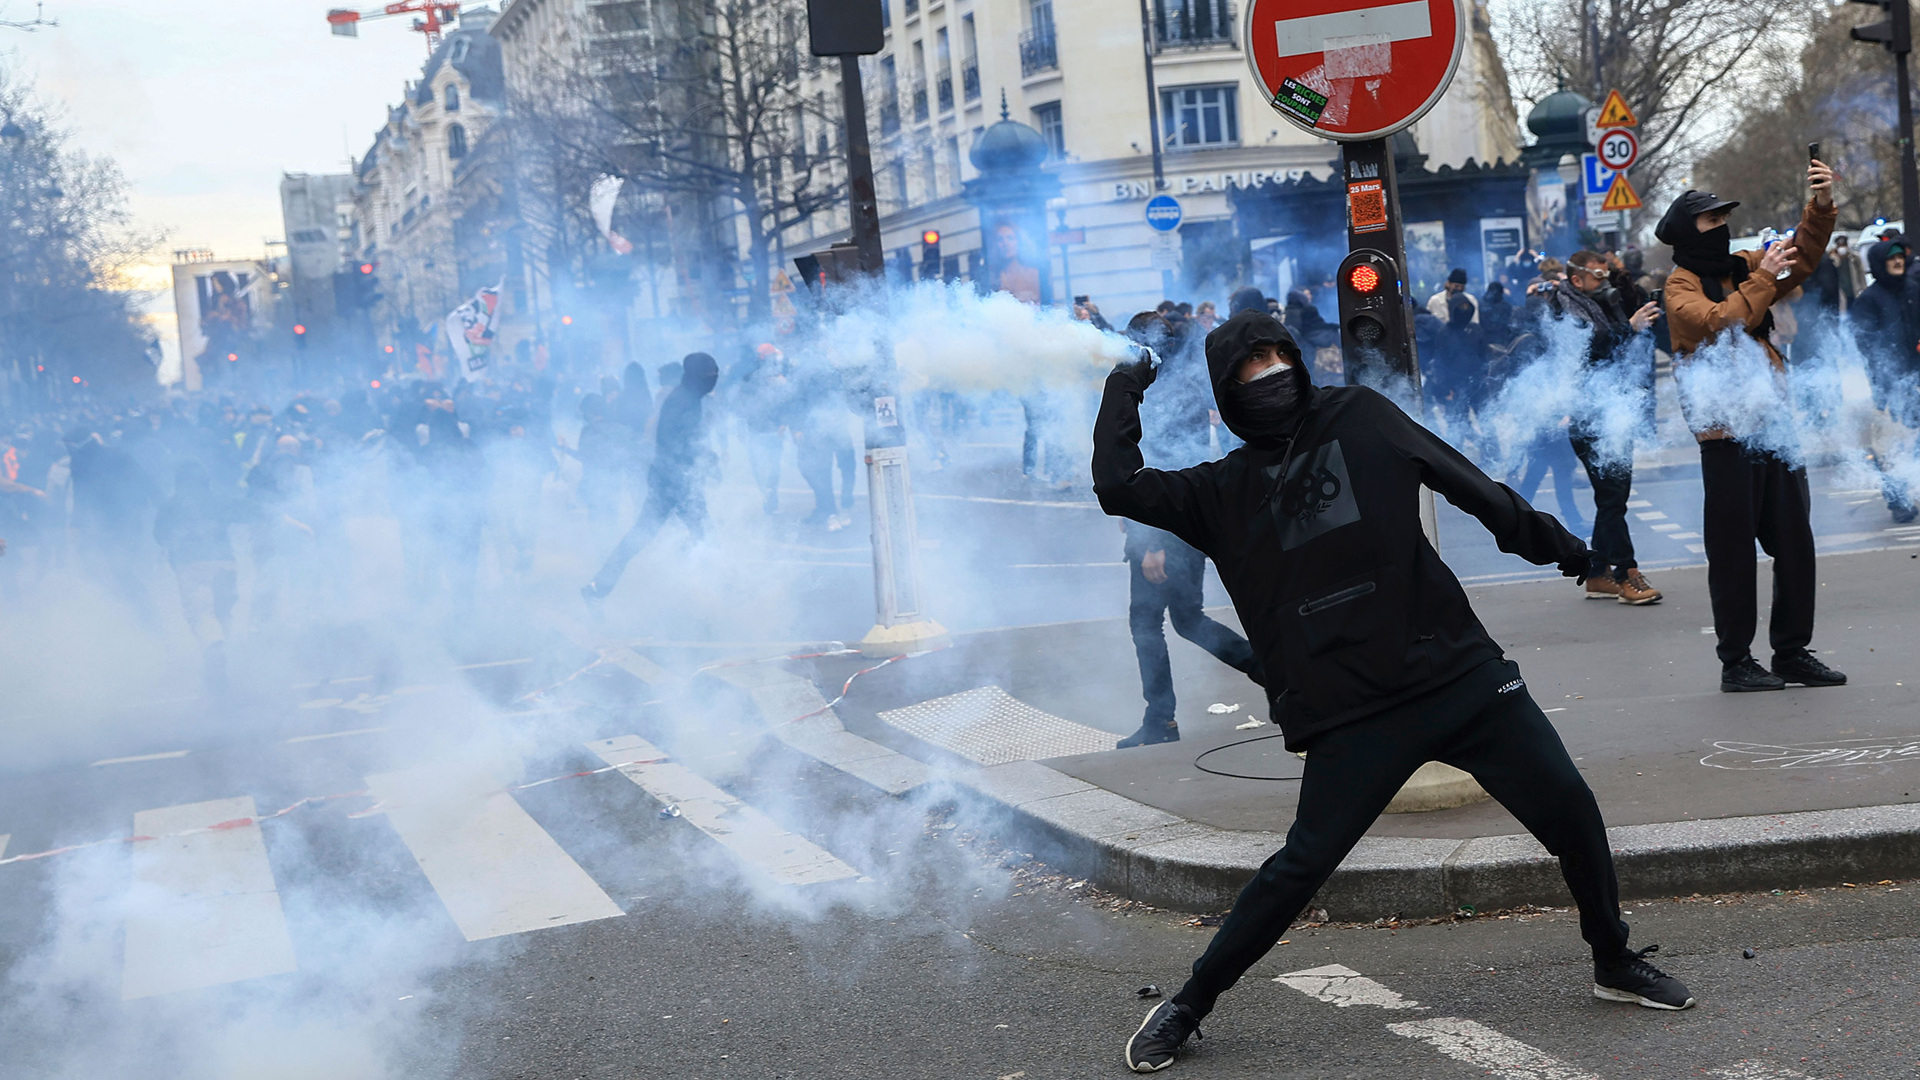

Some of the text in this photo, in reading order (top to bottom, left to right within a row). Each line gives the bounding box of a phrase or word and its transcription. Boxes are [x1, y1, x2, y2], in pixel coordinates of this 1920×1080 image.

[1284, 79, 1327, 106] LES RICHES
[1291, 93, 1311, 106] SONT
[1276, 93, 1320, 120] COUPABLES
[1607, 141, 1629, 159] 30
[1595, 162, 1613, 187] P
[1350, 184, 1381, 194] 25 Mars
